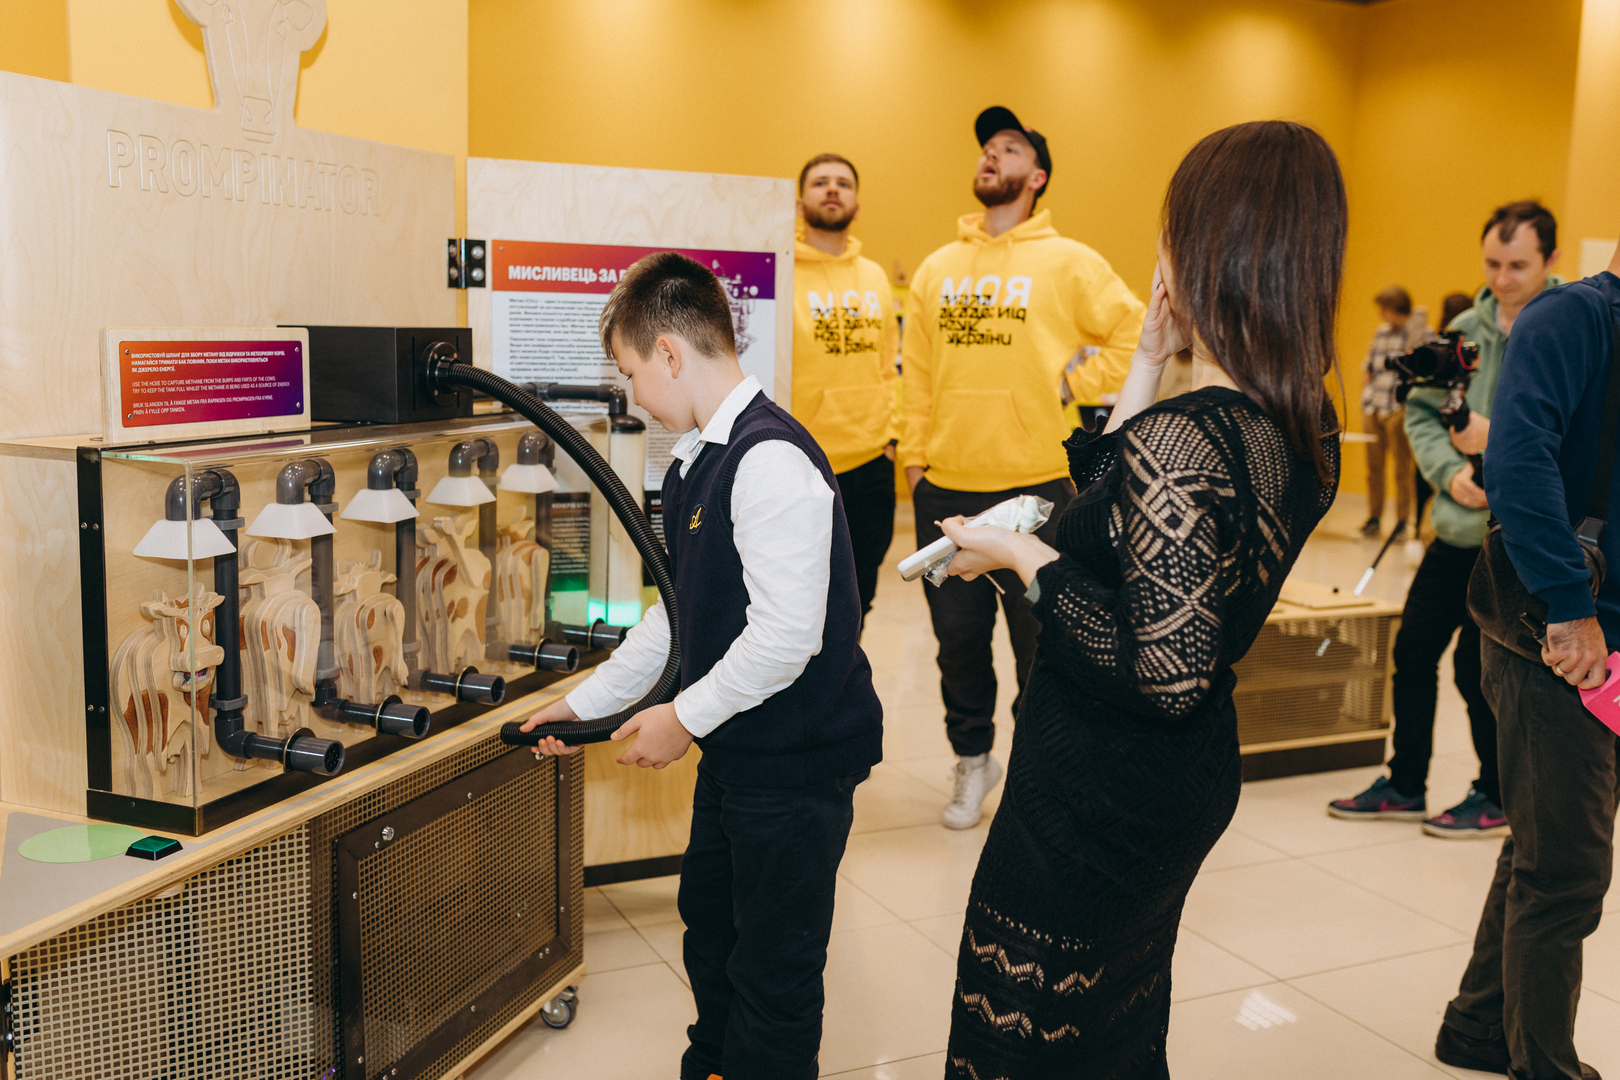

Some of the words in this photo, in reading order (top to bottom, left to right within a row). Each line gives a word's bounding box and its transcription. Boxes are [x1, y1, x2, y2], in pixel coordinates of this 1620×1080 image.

[107, 129, 381, 217] PROMPINATOR
[508, 265, 598, 284] МИСЛИВЕЦЬ
[598, 268, 618, 284] ЗА
[940, 274, 1033, 308] МОЯ
